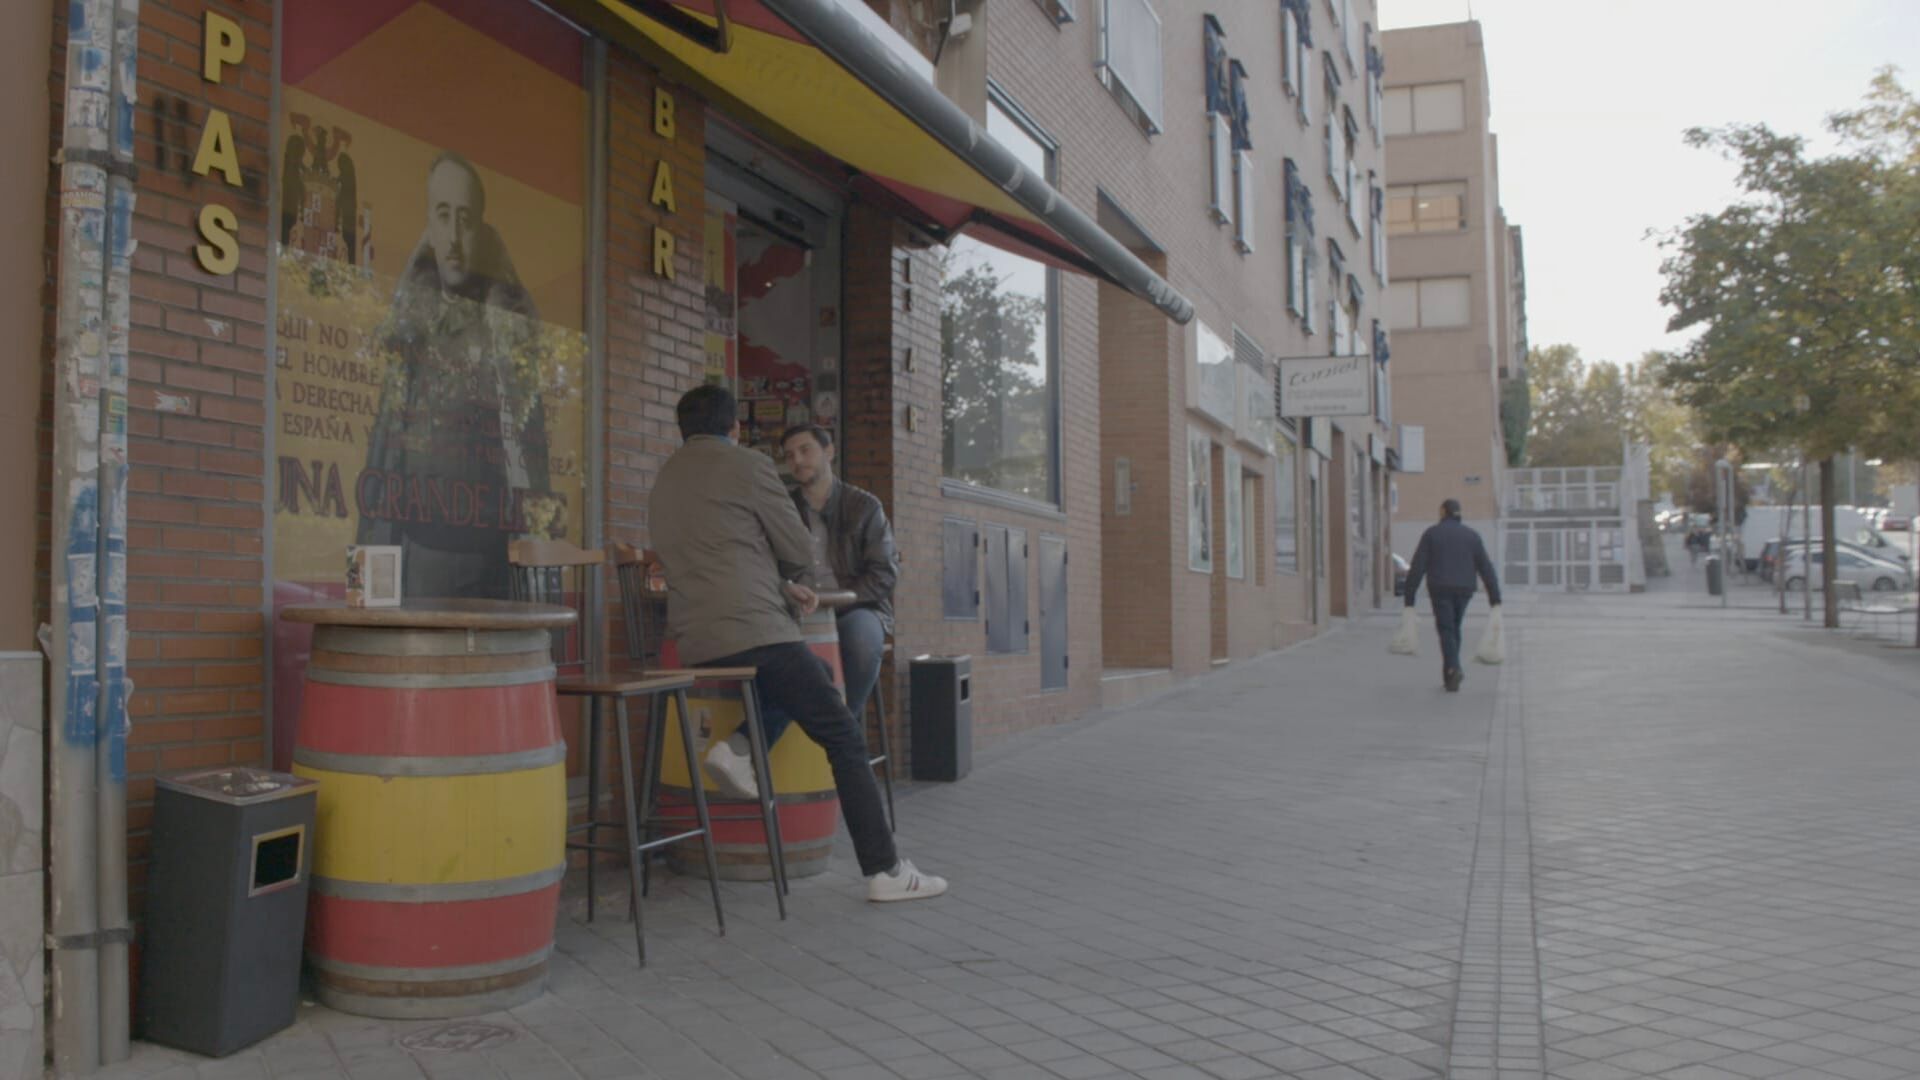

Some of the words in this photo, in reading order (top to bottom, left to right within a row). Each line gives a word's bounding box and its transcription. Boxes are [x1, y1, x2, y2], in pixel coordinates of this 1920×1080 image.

[651, 87, 677, 281] BAR
[319, 322, 349, 350] NO
[303, 351, 383, 387] HOMBRE
[282, 412, 355, 444] ESPAÑA
[357, 467, 490, 529] GRANDE
